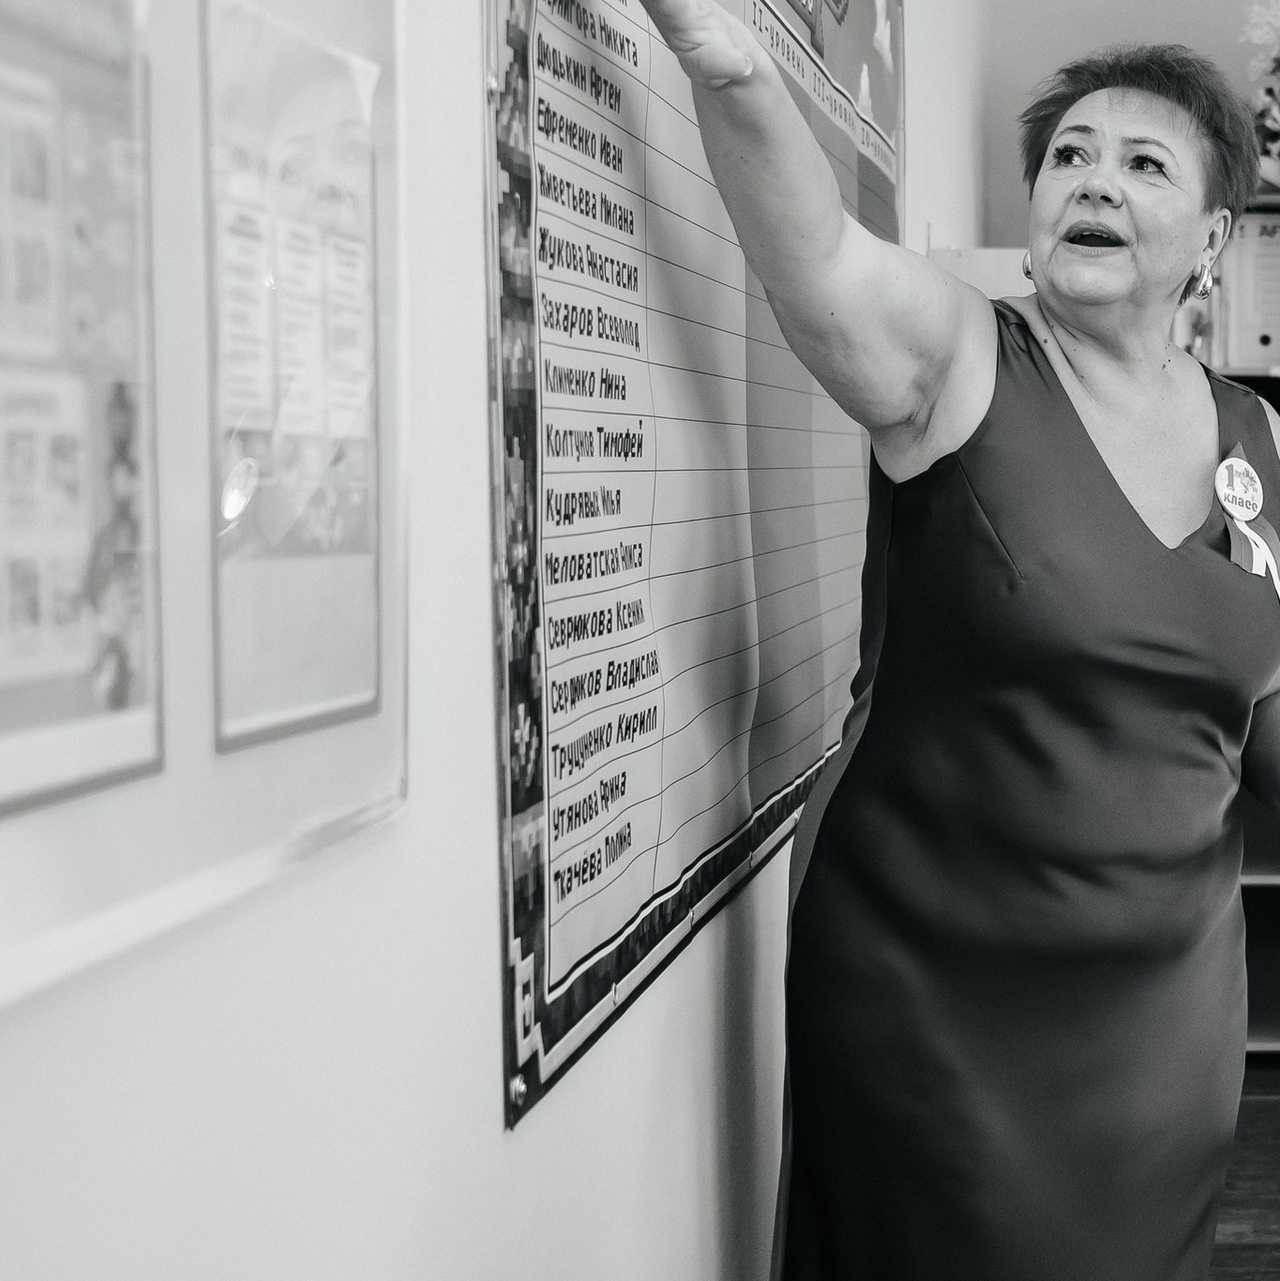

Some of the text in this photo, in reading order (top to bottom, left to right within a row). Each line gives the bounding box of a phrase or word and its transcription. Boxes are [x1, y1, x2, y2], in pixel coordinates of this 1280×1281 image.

[599, 14, 638, 68] Никита
[537, 32, 621, 114] Дюдькин Артем
[537, 97, 623, 174] Ефременко Иван
[538, 162, 634, 235] Живетьева Милана
[538, 226, 638, 293] Жукова Анастасия
[541, 292, 641, 353] Захаров Всеволод
[545, 359, 626, 401] Клименко Нина
[546, 419, 643, 462] Колтунов Тимофей
[545, 552, 621, 586] Меловатская
[549, 608, 613, 650] Севрюкова
[551, 668, 602, 714] Сердюков
[616, 705, 657, 743] Кирилл
[552, 771, 626, 842] Утянова Арина
[554, 821, 632, 904] Ткачёва Полина
